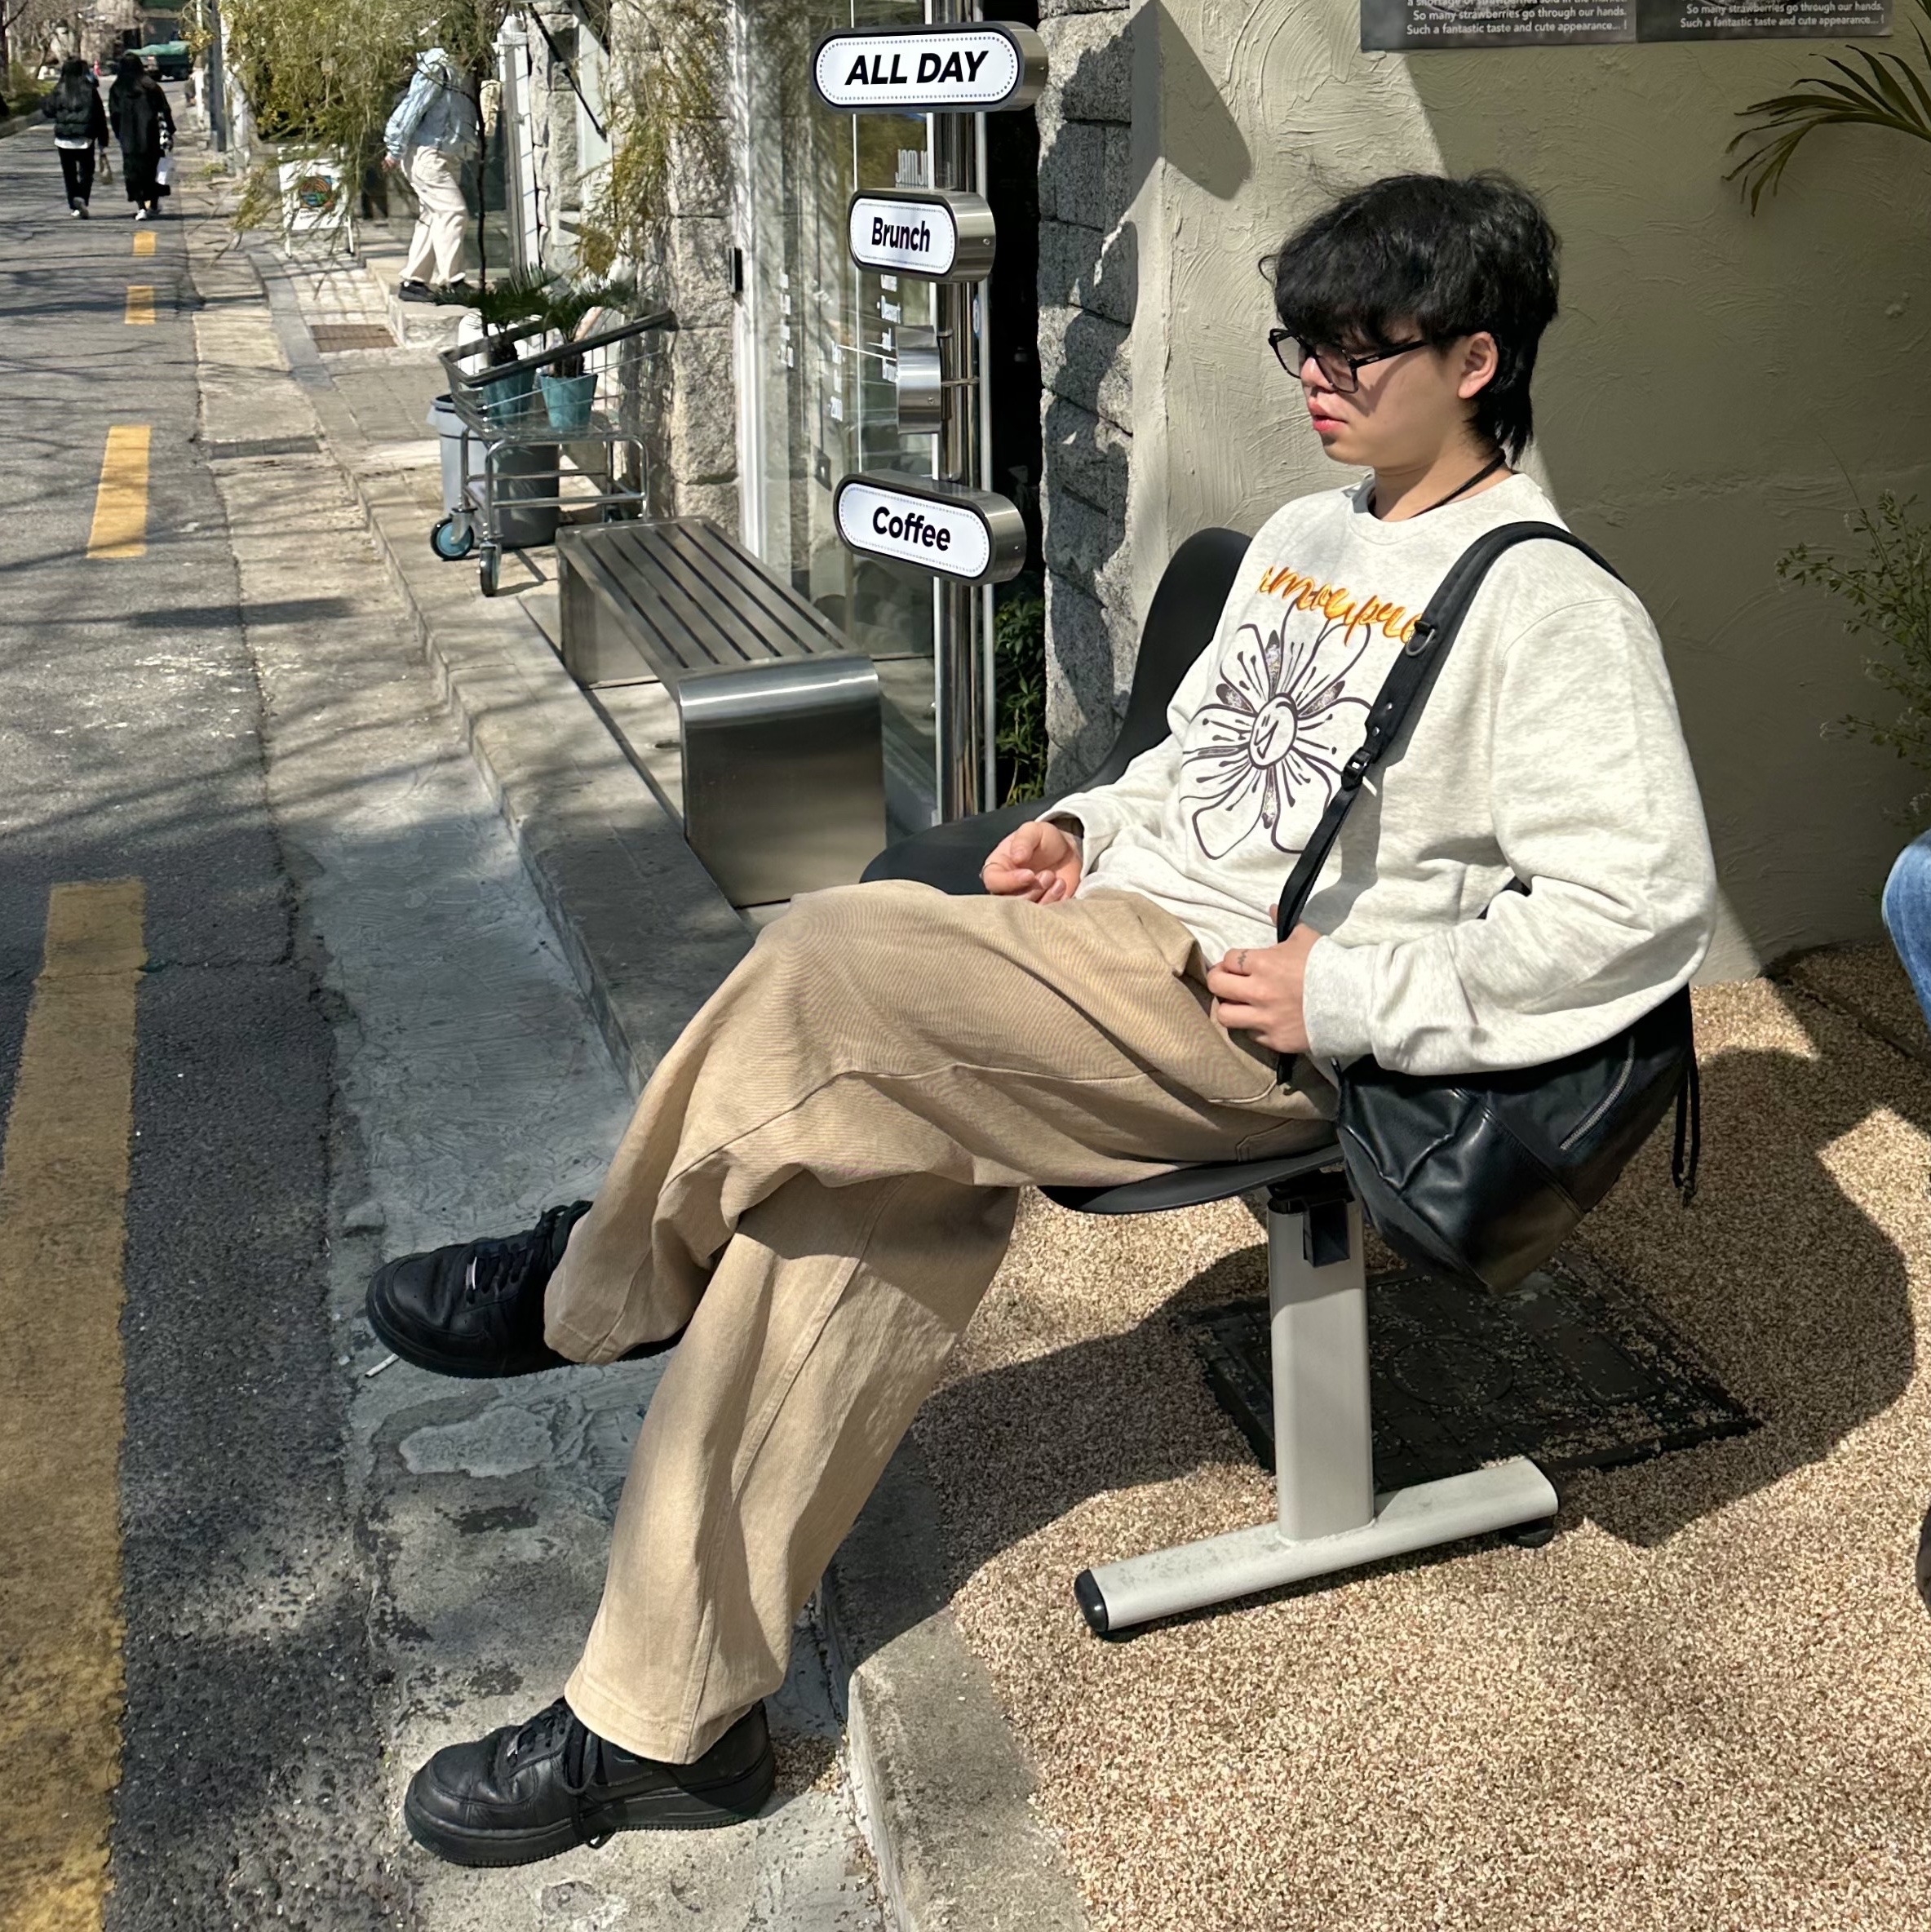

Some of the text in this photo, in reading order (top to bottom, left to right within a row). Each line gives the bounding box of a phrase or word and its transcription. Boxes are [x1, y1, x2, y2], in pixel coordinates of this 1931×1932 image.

[1413, 11, 1426, 20] So
[1429, 11, 1456, 22] many
[1459, 9, 1520, 20] strawberries
[1522, 10, 1535, 21] go
[1538, 7, 1576, 20] through
[1579, 9, 1595, 17] our
[1686, 3, 1699, 14] So
[1701, 6, 1727, 16] many
[1729, 3, 1785, 14] strawberries
[1787, 4, 1799, 15] go
[1800, 2, 1836, 14] through
[1837, 3, 1853, 11] our
[1406, 24, 1431, 35] Such
[1433, 25, 1439, 34] a
[1442, 24, 1484, 34] fantastic
[1486, 24, 1511, 33] taste
[1513, 22, 1532, 32] and
[1535, 23, 1555, 32] cute
[1681, 17, 1703, 28] Such
[1714, 16, 1752, 27] fantastic
[1754, 17, 1778, 26] taste
[1778, 15, 1796, 26] and
[1798, 16, 1817, 25] cute
[845, 51, 990, 86] ALL DAY
[871, 216, 931, 253] Brunch
[872, 506, 950, 552] Coffee
